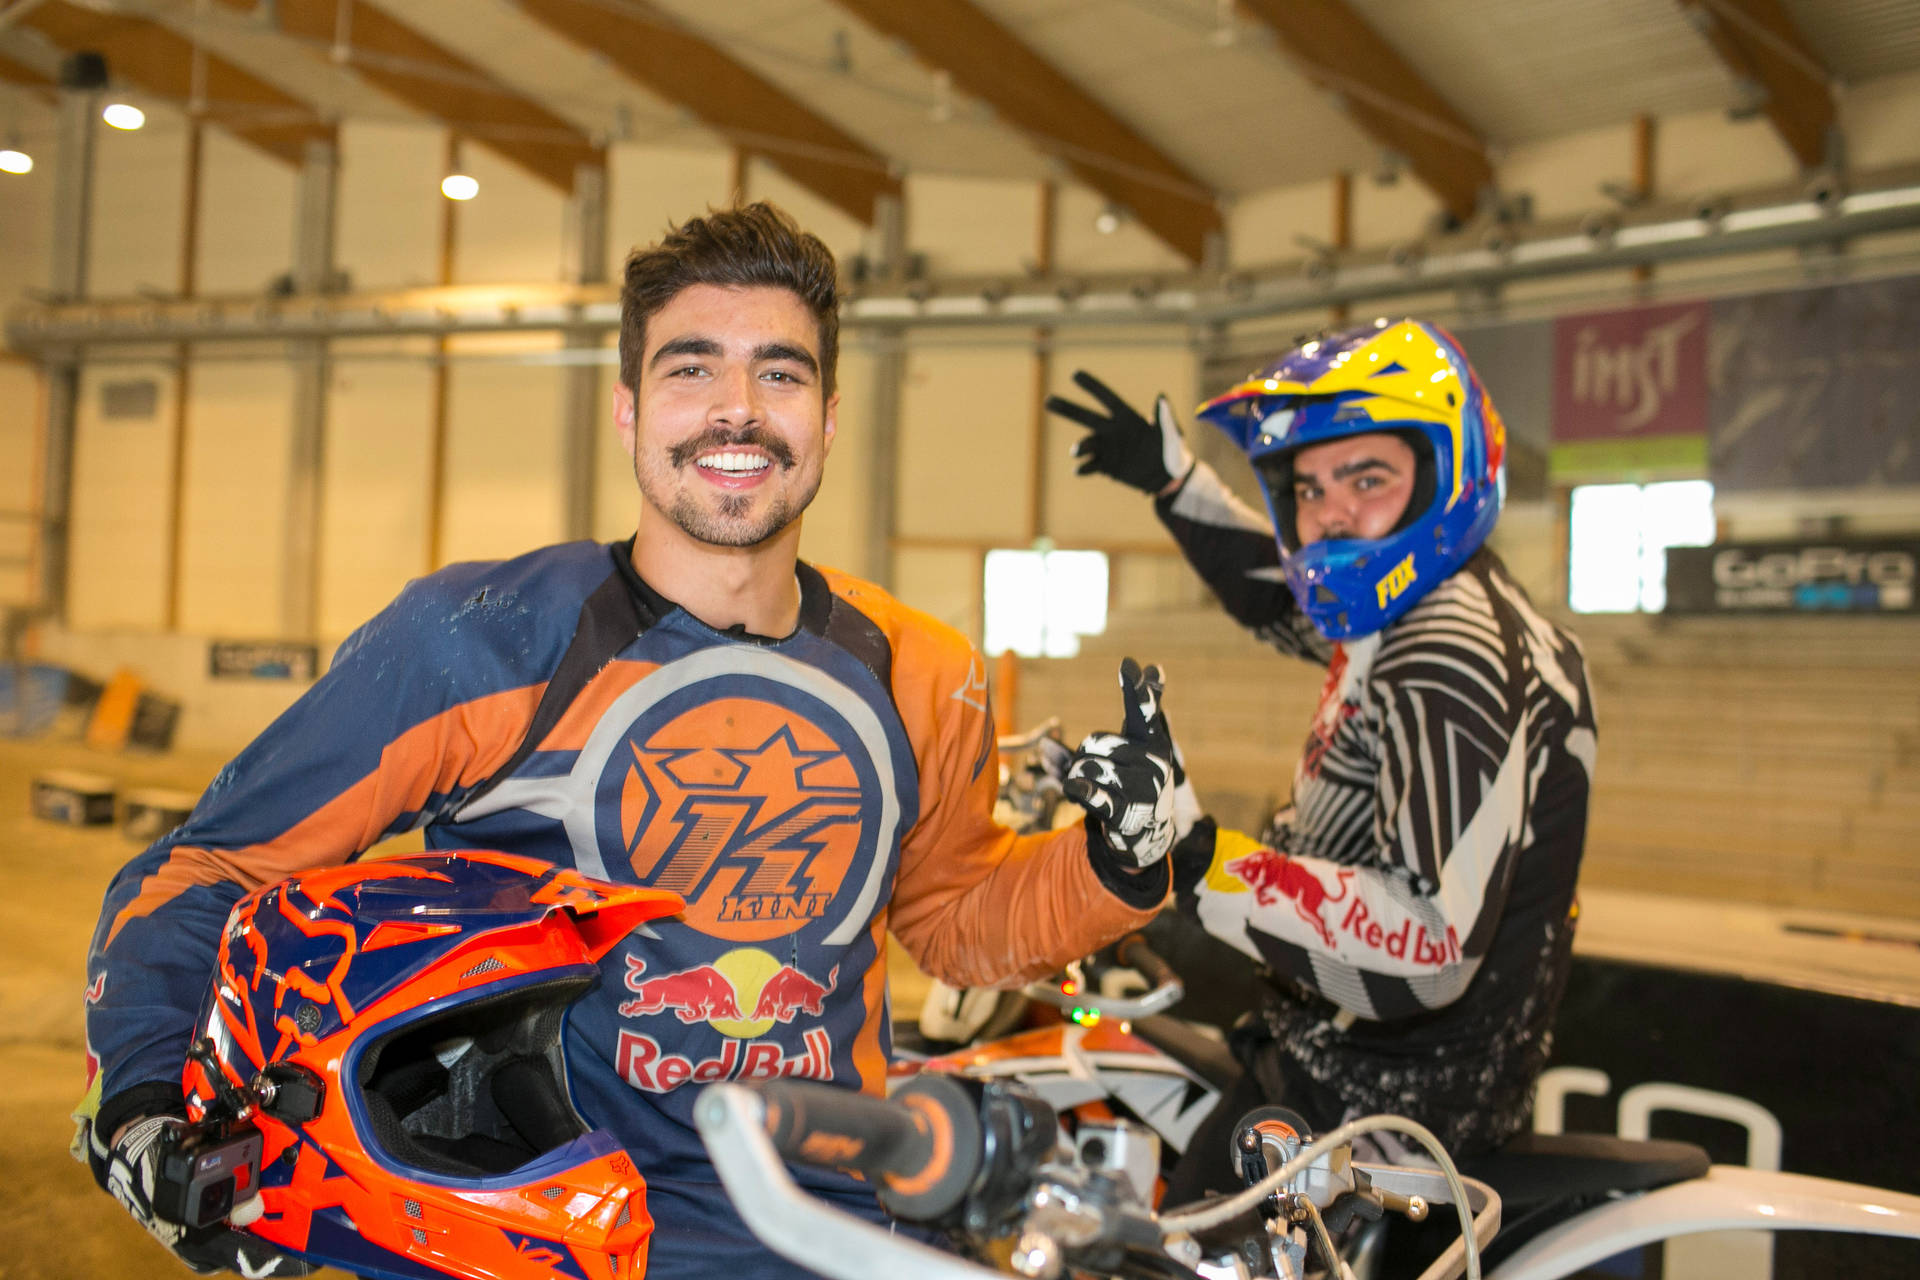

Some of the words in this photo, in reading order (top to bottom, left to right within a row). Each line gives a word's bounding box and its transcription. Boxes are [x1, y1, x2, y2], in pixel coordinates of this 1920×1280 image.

[1376, 552, 1418, 610] FOX
[1714, 547, 1915, 588] GoPro
[717, 893, 832, 922] KINI
[1341, 896, 1411, 960] Red
[616, 1027, 740, 1094] Red
[734, 1026, 834, 1083] Bull
